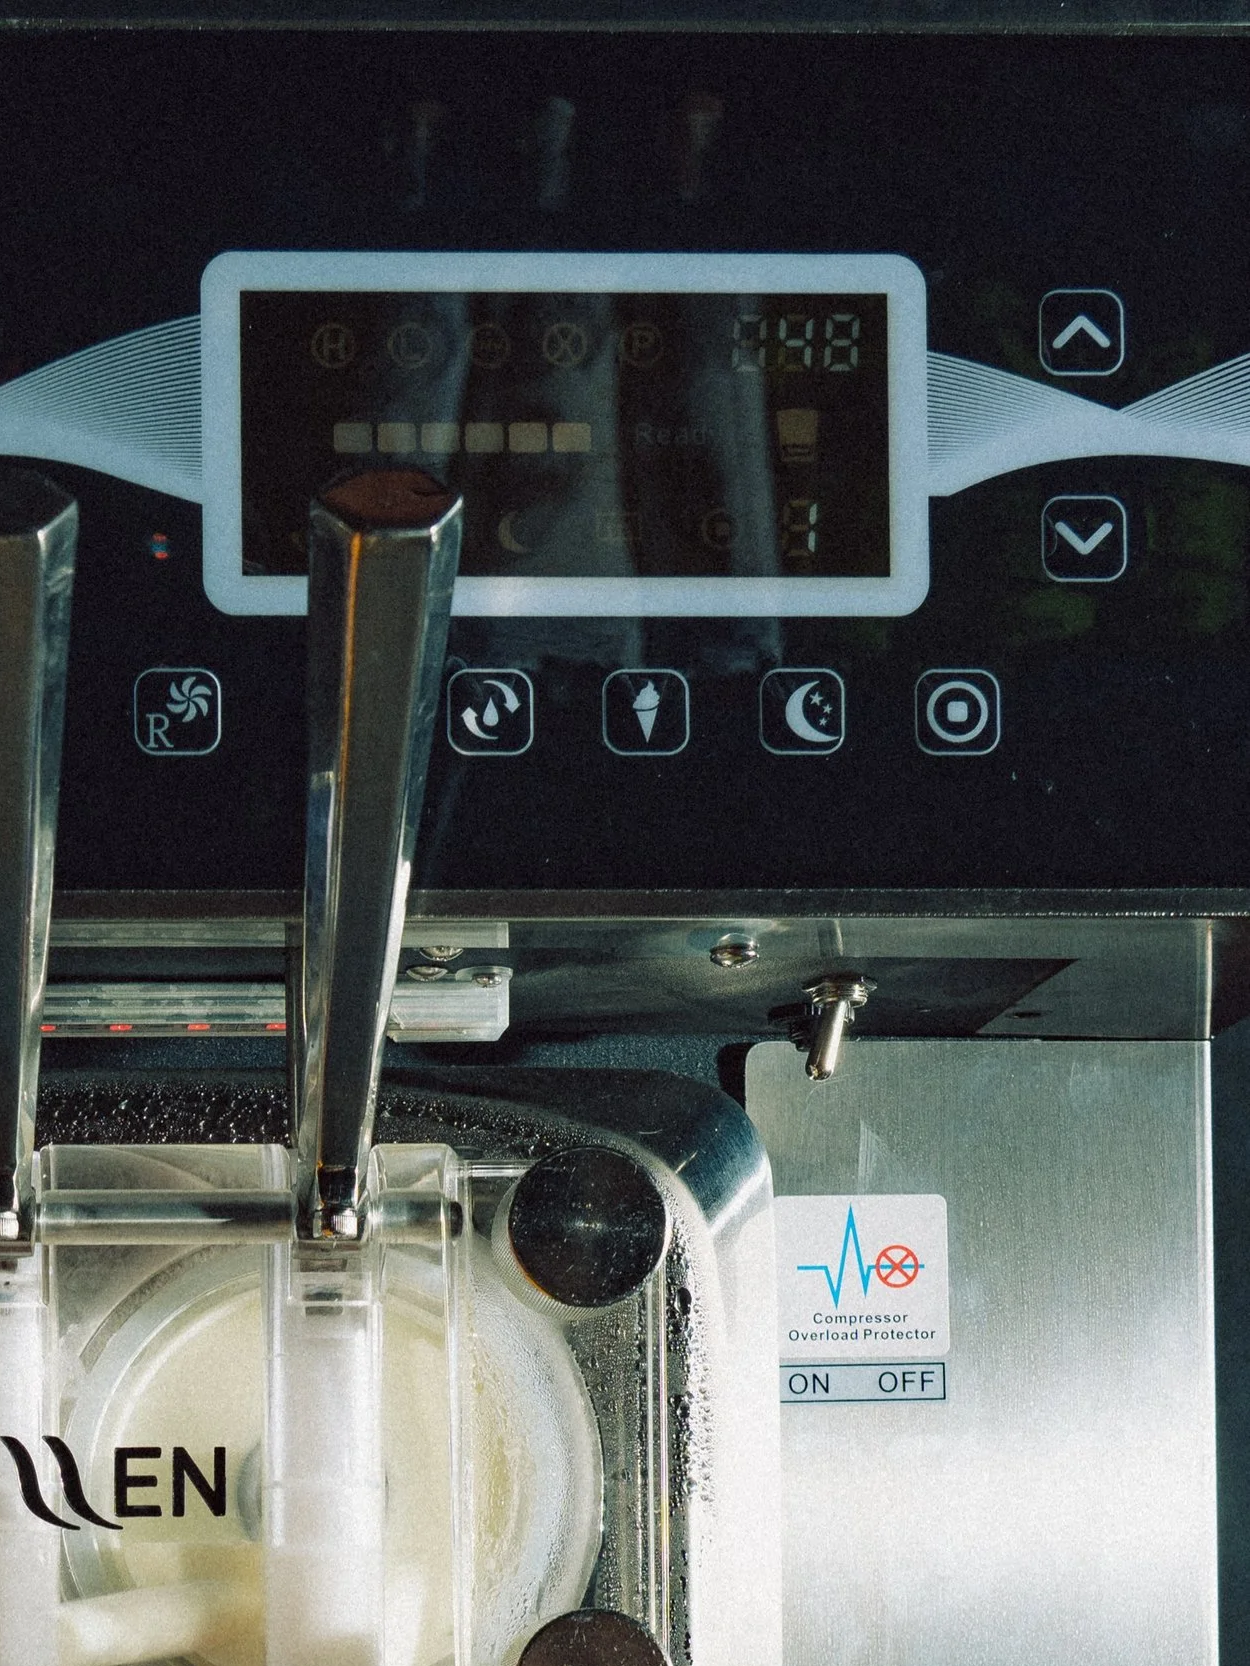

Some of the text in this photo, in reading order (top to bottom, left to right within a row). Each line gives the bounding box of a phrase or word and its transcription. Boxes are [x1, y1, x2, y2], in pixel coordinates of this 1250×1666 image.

[146, 714, 174, 749] R
[813, 1312, 909, 1326] Compressor
[788, 1328, 936, 1341] Overload Protector
[788, 1371, 935, 1394] ON OFF
